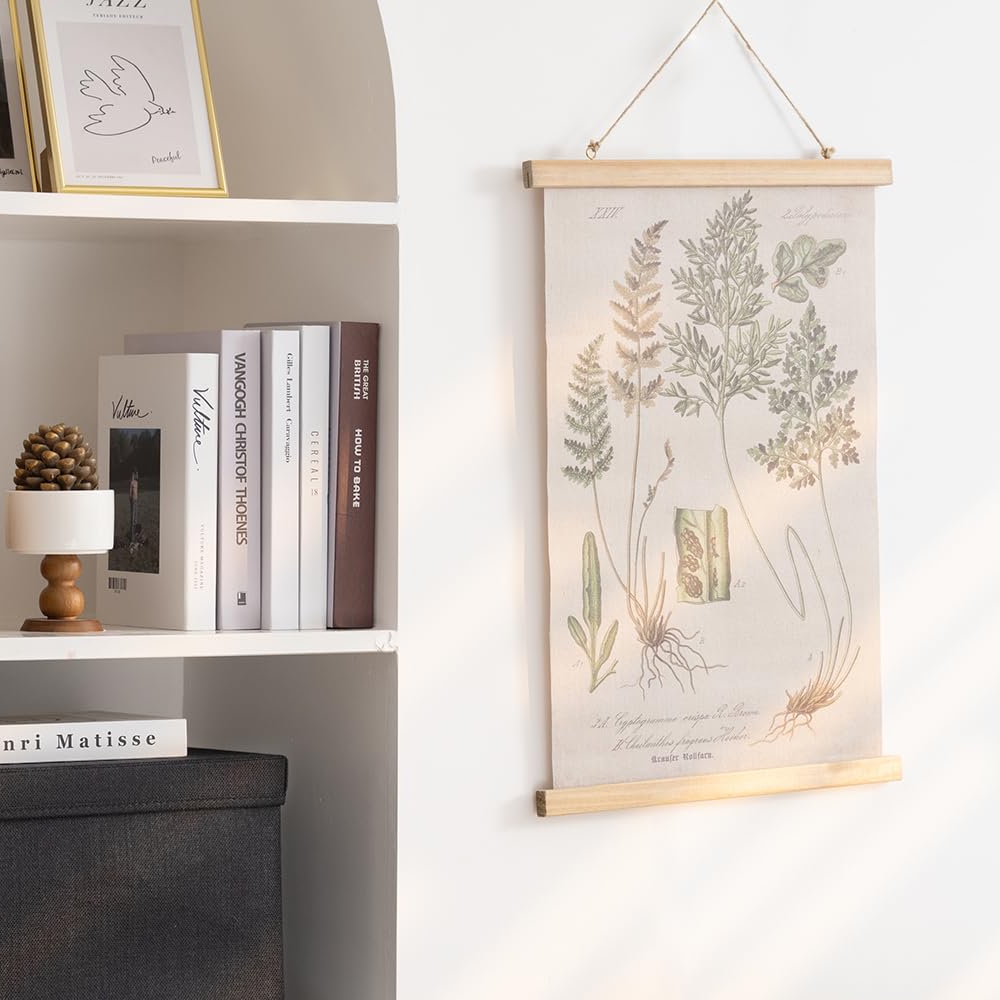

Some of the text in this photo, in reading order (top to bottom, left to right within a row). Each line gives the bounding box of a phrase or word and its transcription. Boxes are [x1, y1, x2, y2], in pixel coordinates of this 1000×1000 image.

[285, 378, 293, 412] Lambert
[234, 352, 248, 546] VANGOGH CHRISTOF THOENES
[310, 430, 319, 482] CEREAL
[352, 429, 362, 508] HOW TO BAKE
[56, 731, 156, 749] Matisse
